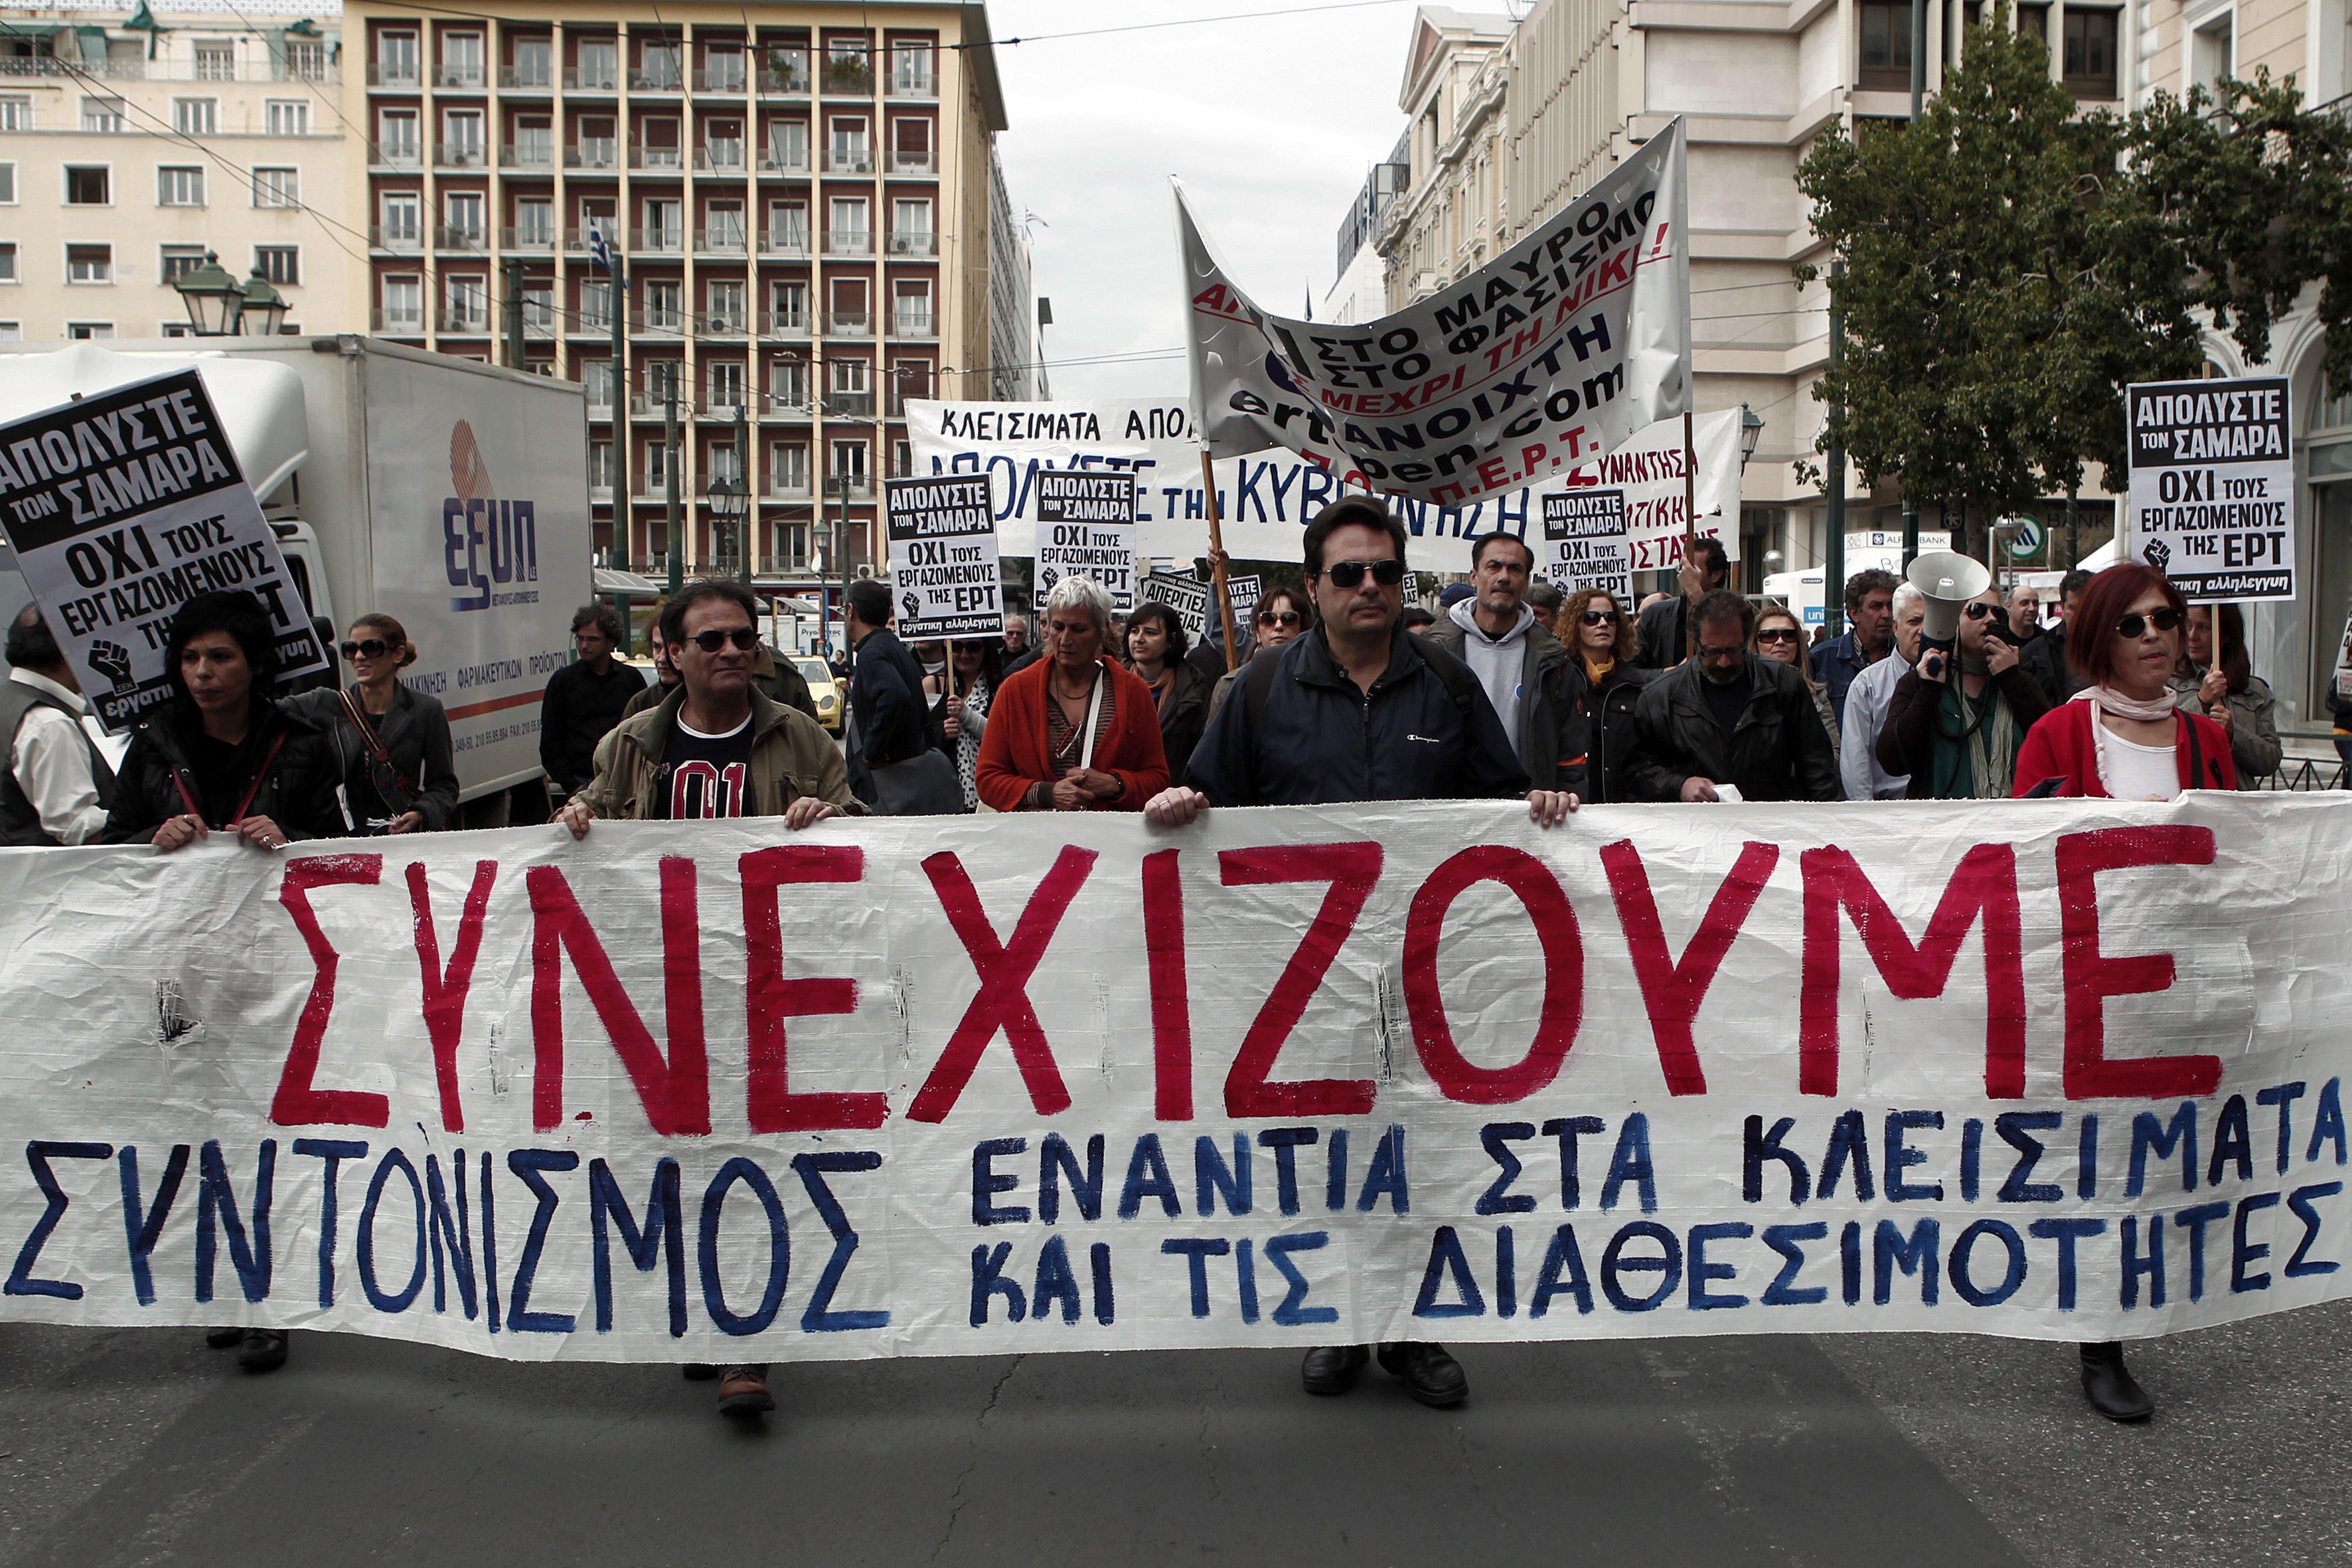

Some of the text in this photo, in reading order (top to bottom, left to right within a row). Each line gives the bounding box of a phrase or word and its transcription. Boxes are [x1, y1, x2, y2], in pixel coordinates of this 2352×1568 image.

[1309, 327, 1419, 362] ΣΤΟ
[1434, 201, 1609, 335] ΜΑΥΡΟ
[1321, 364, 1466, 414] ΜΕΧΡΙ
[1484, 315, 1543, 372] ΤΗ
[1322, 353, 1431, 388] ΣΤΟ
[1344, 313, 1612, 452] ΑΝΟΙΧΤΗ
[2136, 389, 2281, 427] ΑΠΟΛΥΣΤΕ
[941, 407, 1193, 441] ΚΛΕΙΣΙΜΑΤΑ ΑΠΟ
[0, 388, 208, 495] ΑΠΟΛΥΣΤΕ
[2140, 424, 2282, 459] ΤΟΝ ΣΑΜΑΡΑ
[9, 438, 230, 525] ΤΟΝ ΣΑΜΑΡΑ
[890, 482, 986, 511] ΑΠΟΛΥΣΤΕ
[1041, 477, 1131, 499] ΑΠΟΛΥΣΤΕ
[2159, 470, 2268, 503] ΟΧΙ ΤΟΥΣ
[894, 508, 990, 534] ΤΟΝ ΣΑΜΑΡΑ
[1043, 499, 1131, 521] ΤΟΝ ΣΑΜΑΡΑ
[1546, 496, 1621, 518] ΑΠΟΛΥΣΤΕ
[2141, 502, 2286, 532] ΕΡΓΑΖΟΜΕΝΟΥΣ
[1053, 525, 1120, 547] ΟΧΙ ΤΟΥΣ
[1549, 515, 1623, 536] ΤΟΝ ΣΑΜΑΡΑ
[64, 514, 235, 589] ΟΧΙ ΤΟΥΣ
[908, 541, 982, 566] ΟΧΙ ΤΟΥΣ
[1041, 548, 1130, 566] ΕΡΓΑΖΟΜΕΝΟΥΣ
[1560, 541, 1617, 560] ΟΧΙ ΤΟΥΣ
[2183, 532, 2286, 567] ΤΗΣ ΕΡΤ
[898, 564, 995, 588] ΕΡΓΑΖΟΜΕΝΟΥΣ
[1091, 568, 1130, 589] ΕΡΤ
[1551, 558, 1626, 578] ΕΡΓΑΖΟΜΕΝΟΥΣ
[58, 540, 275, 637] ΕΡΓΑΖΟΜΕΝΟΥΣ
[927, 586, 996, 612] ΤΗΣ ΕΡΤ
[1146, 584, 1206, 614] ΑΠΕΡΓΙΕΣ
[1574, 575, 1627, 594] ΤΗΣ ΕΡΤ
[137, 613, 175, 651] ΤΗ
[457, 659, 522, 689] ΦΑΡΜΑΚΕΥΤΙΚΩΝ
[269, 825, 2223, 1137] ΣΥΝΕΧΙΖΟΥΜΕ
[973, 1076, 2348, 1226] ΕΝΑΝΤΙΑ ΣΤΑ ΚΛΕΙΣΙΜΑΤΑ
[4, 1138, 890, 1338] ΣΥΝΤΟΝΙΣΜΟΣ
[969, 1181, 2343, 1327] ΚΑΙ ΤΙΣ ΔΙΑΘΕΣΙΜΟΤΗΤΕΣ
